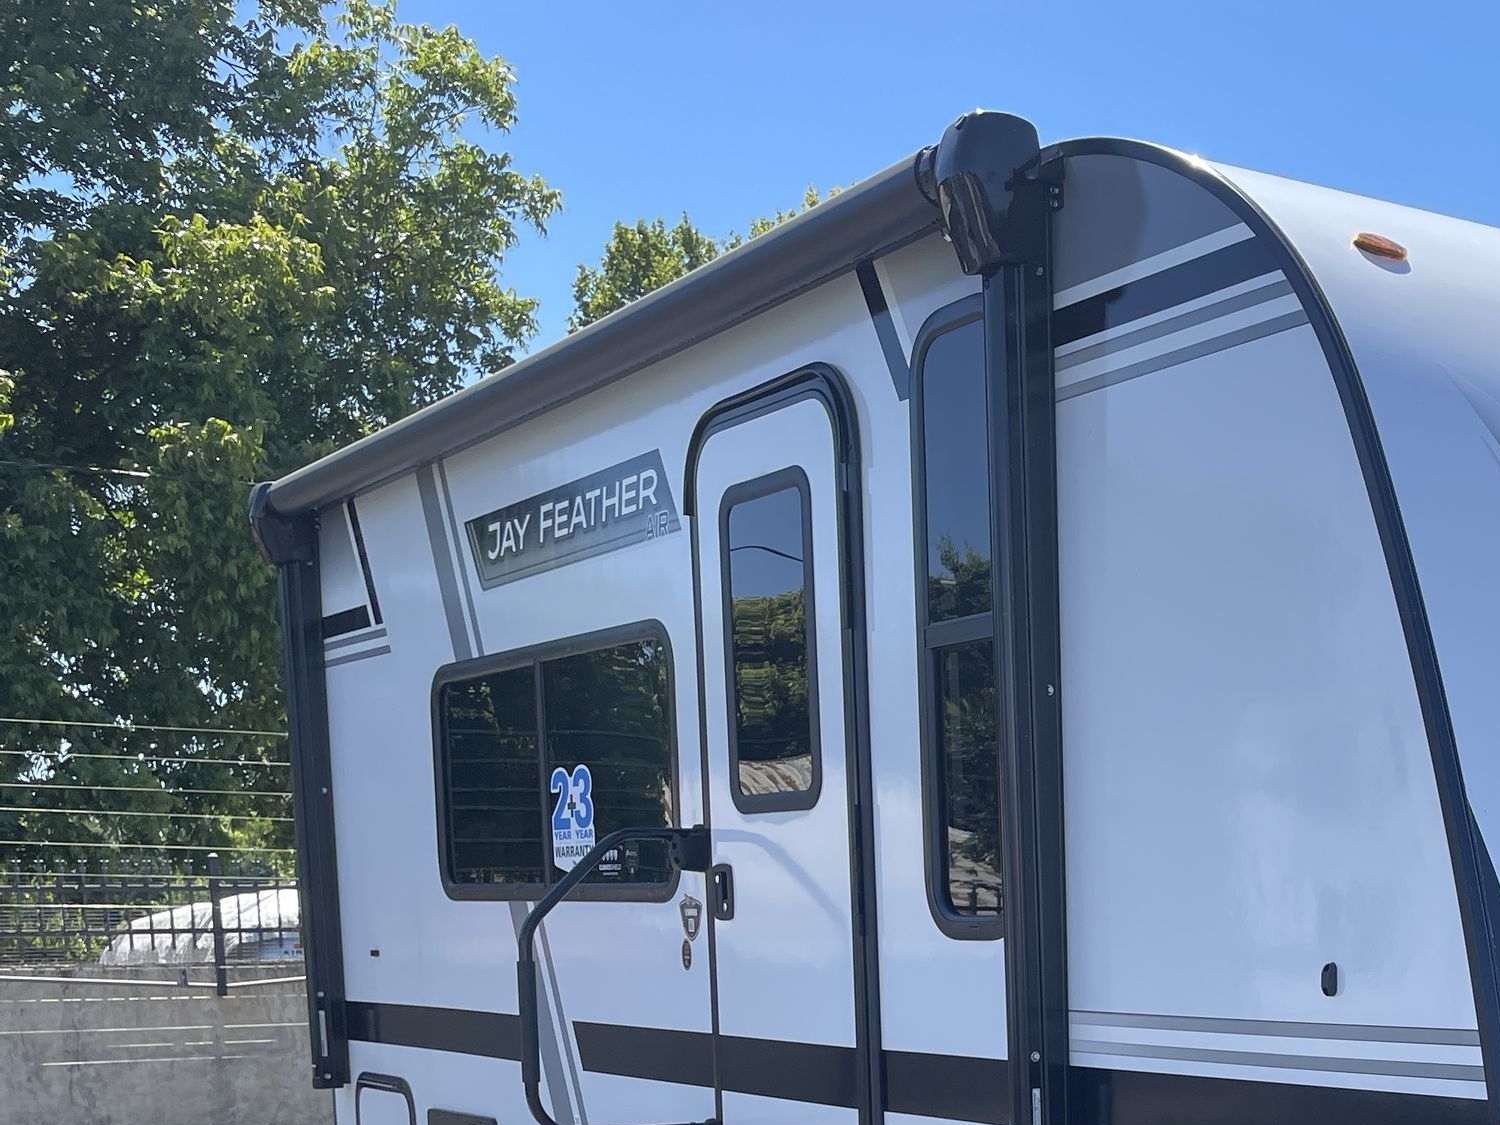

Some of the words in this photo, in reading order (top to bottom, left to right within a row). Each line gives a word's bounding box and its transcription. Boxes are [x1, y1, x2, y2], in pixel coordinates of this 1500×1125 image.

[487, 513, 531, 561] JAY
[539, 468, 658, 543] FEATHER
[645, 509, 669, 541] AIR
[554, 831, 571, 841] YEAR
[575, 829, 593, 840] YEAR
